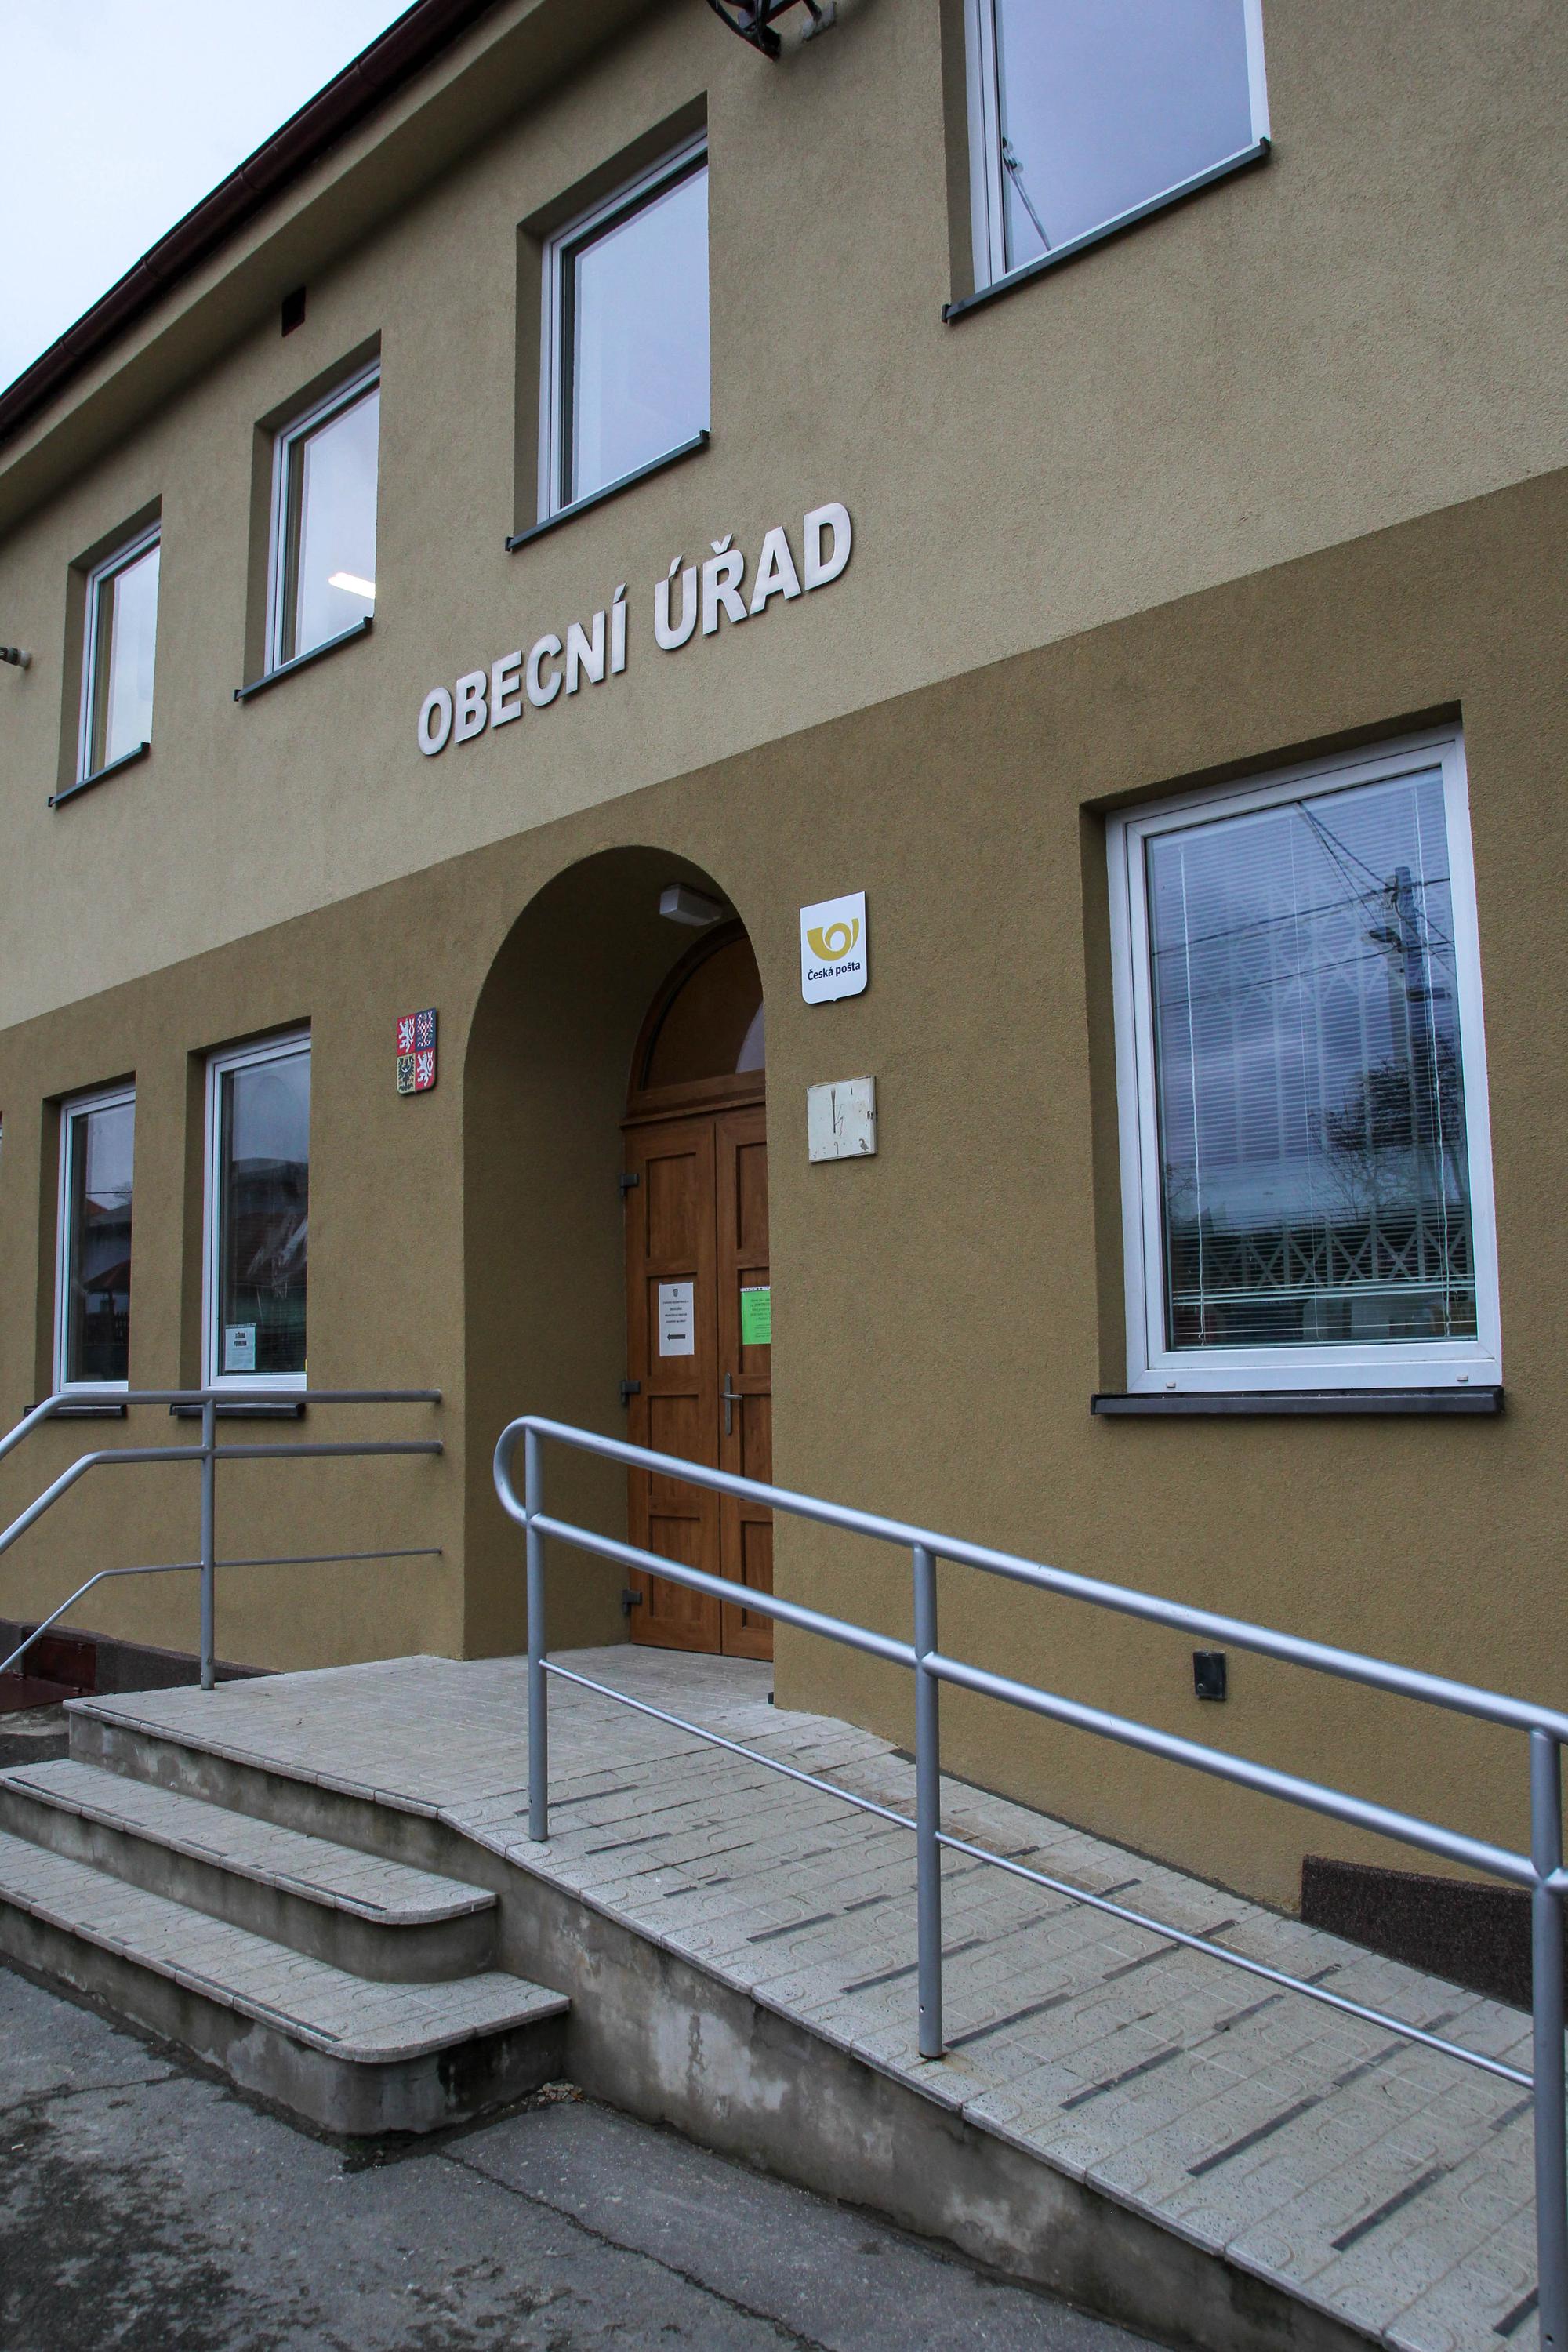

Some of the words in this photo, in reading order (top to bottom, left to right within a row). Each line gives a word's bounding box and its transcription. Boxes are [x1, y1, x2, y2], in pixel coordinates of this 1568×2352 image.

[417, 582, 627, 756] OBECNÍ
[654, 502, 852, 651] ÚŘAD
[808, 966, 833, 981] Česká
[836, 961, 861, 977] pošta
